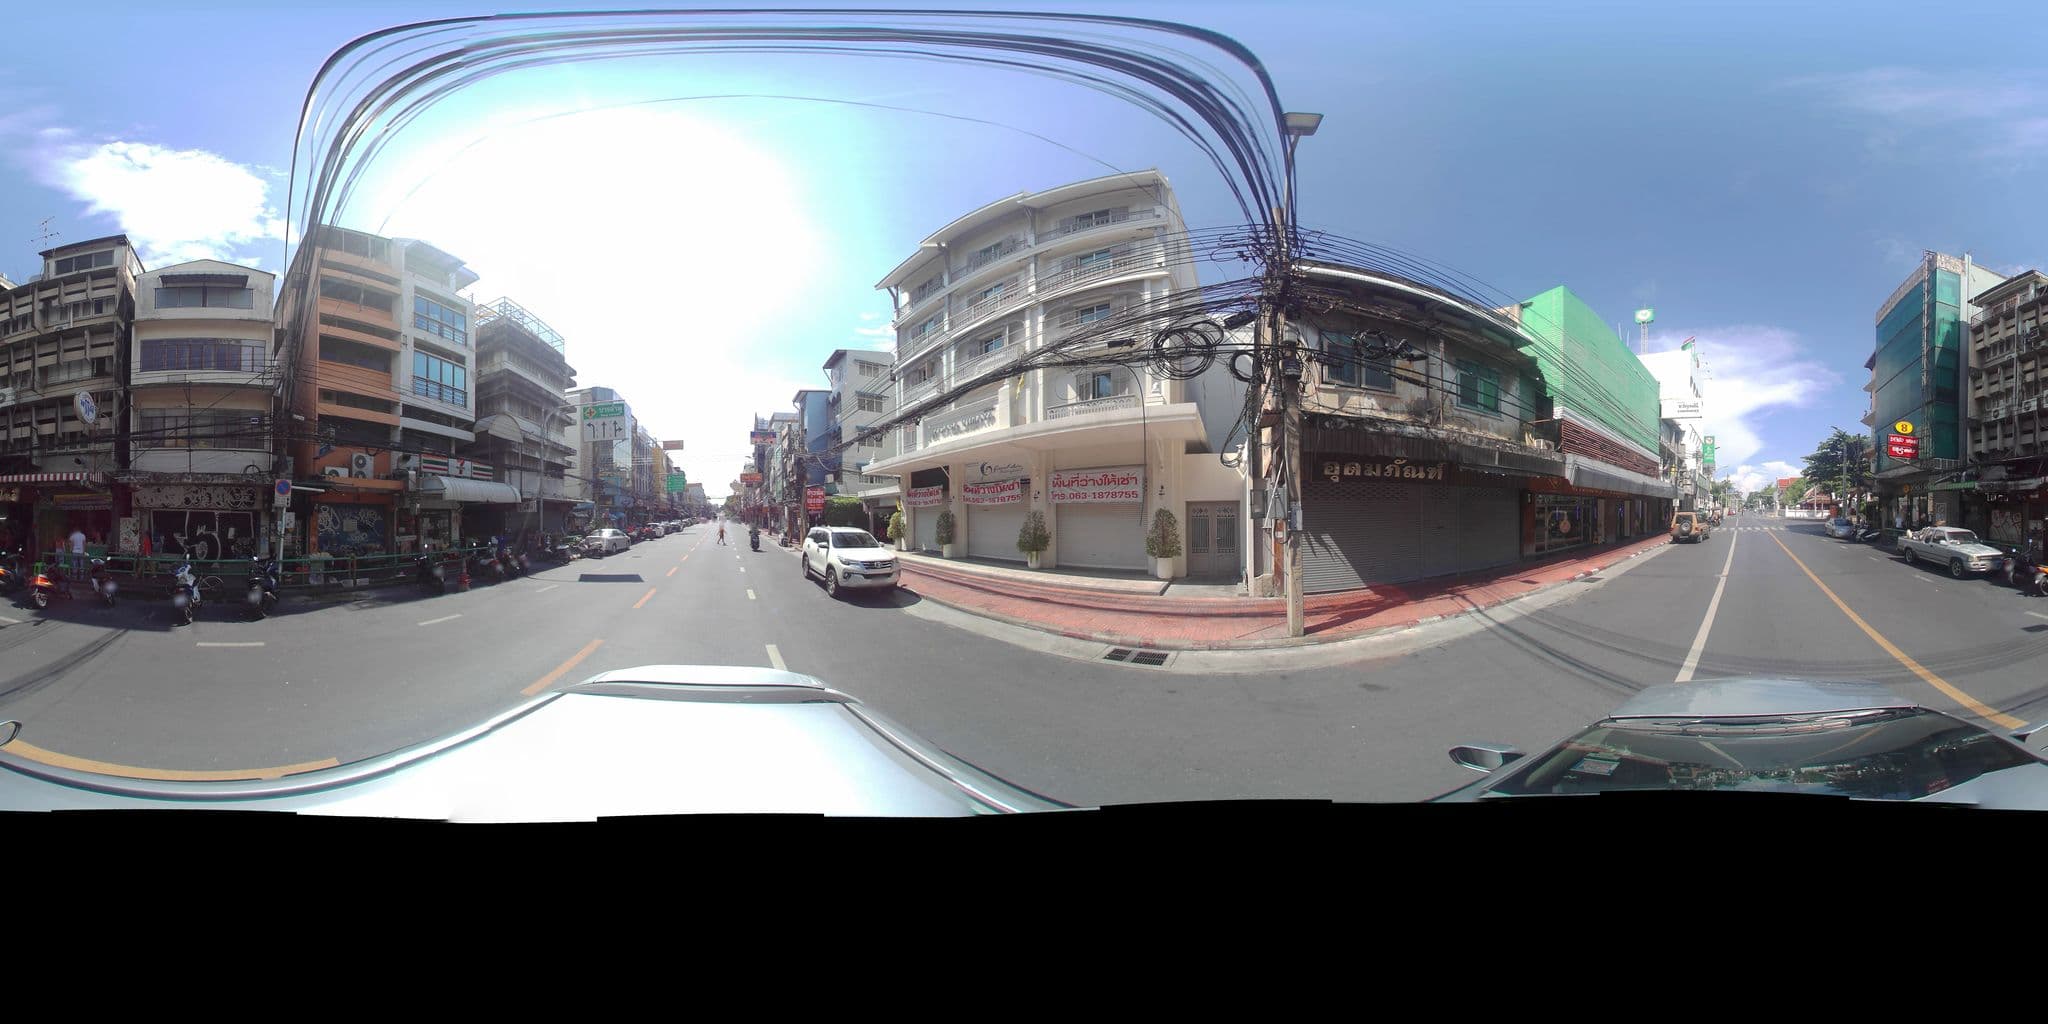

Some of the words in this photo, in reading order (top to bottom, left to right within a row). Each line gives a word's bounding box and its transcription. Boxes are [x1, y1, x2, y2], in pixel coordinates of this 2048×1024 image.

[1052, 473, 1138, 488] พื้นที่ว่างให้เช่า
